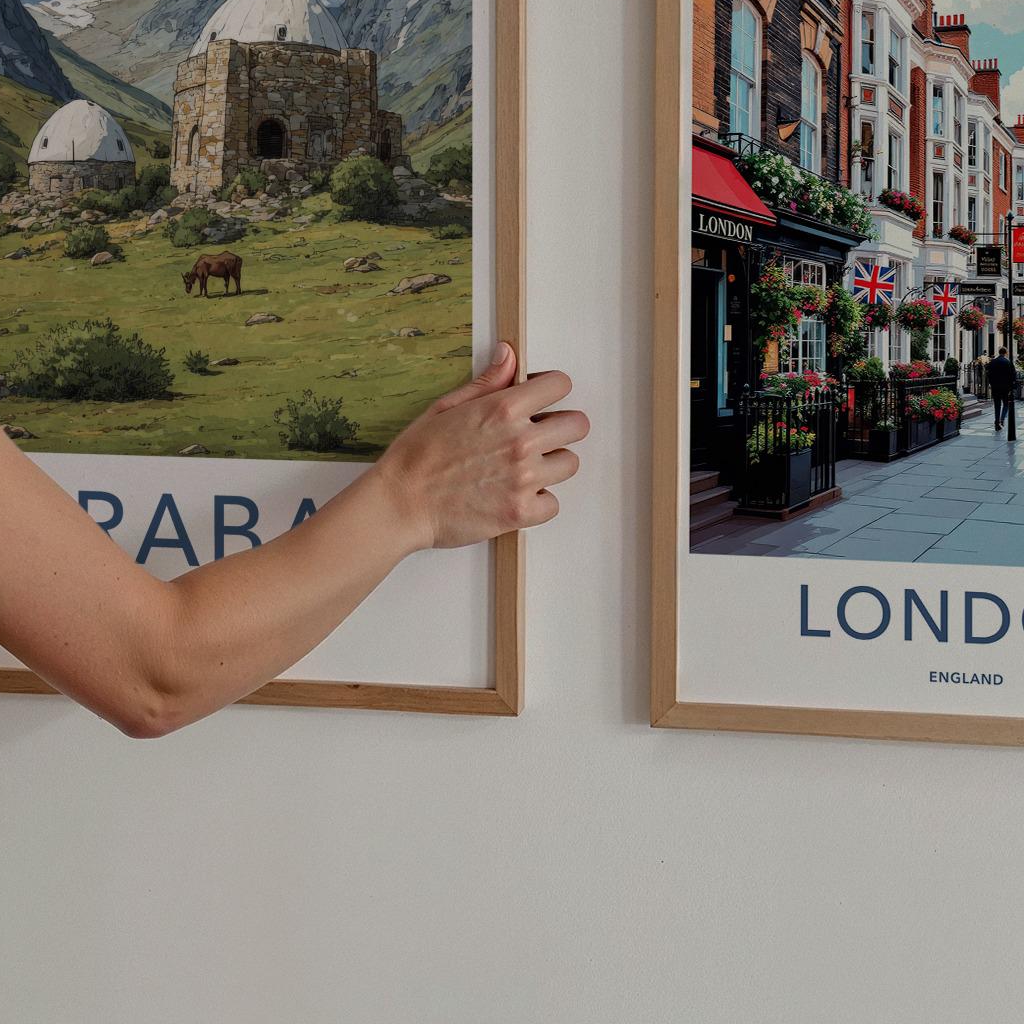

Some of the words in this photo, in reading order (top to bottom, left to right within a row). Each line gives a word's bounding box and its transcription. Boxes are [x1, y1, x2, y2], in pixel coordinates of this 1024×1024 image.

[698, 213, 753, 242] LONDON
[800, 584, 1024, 645] LOND
[929, 671, 1004, 686] ENGLAND
